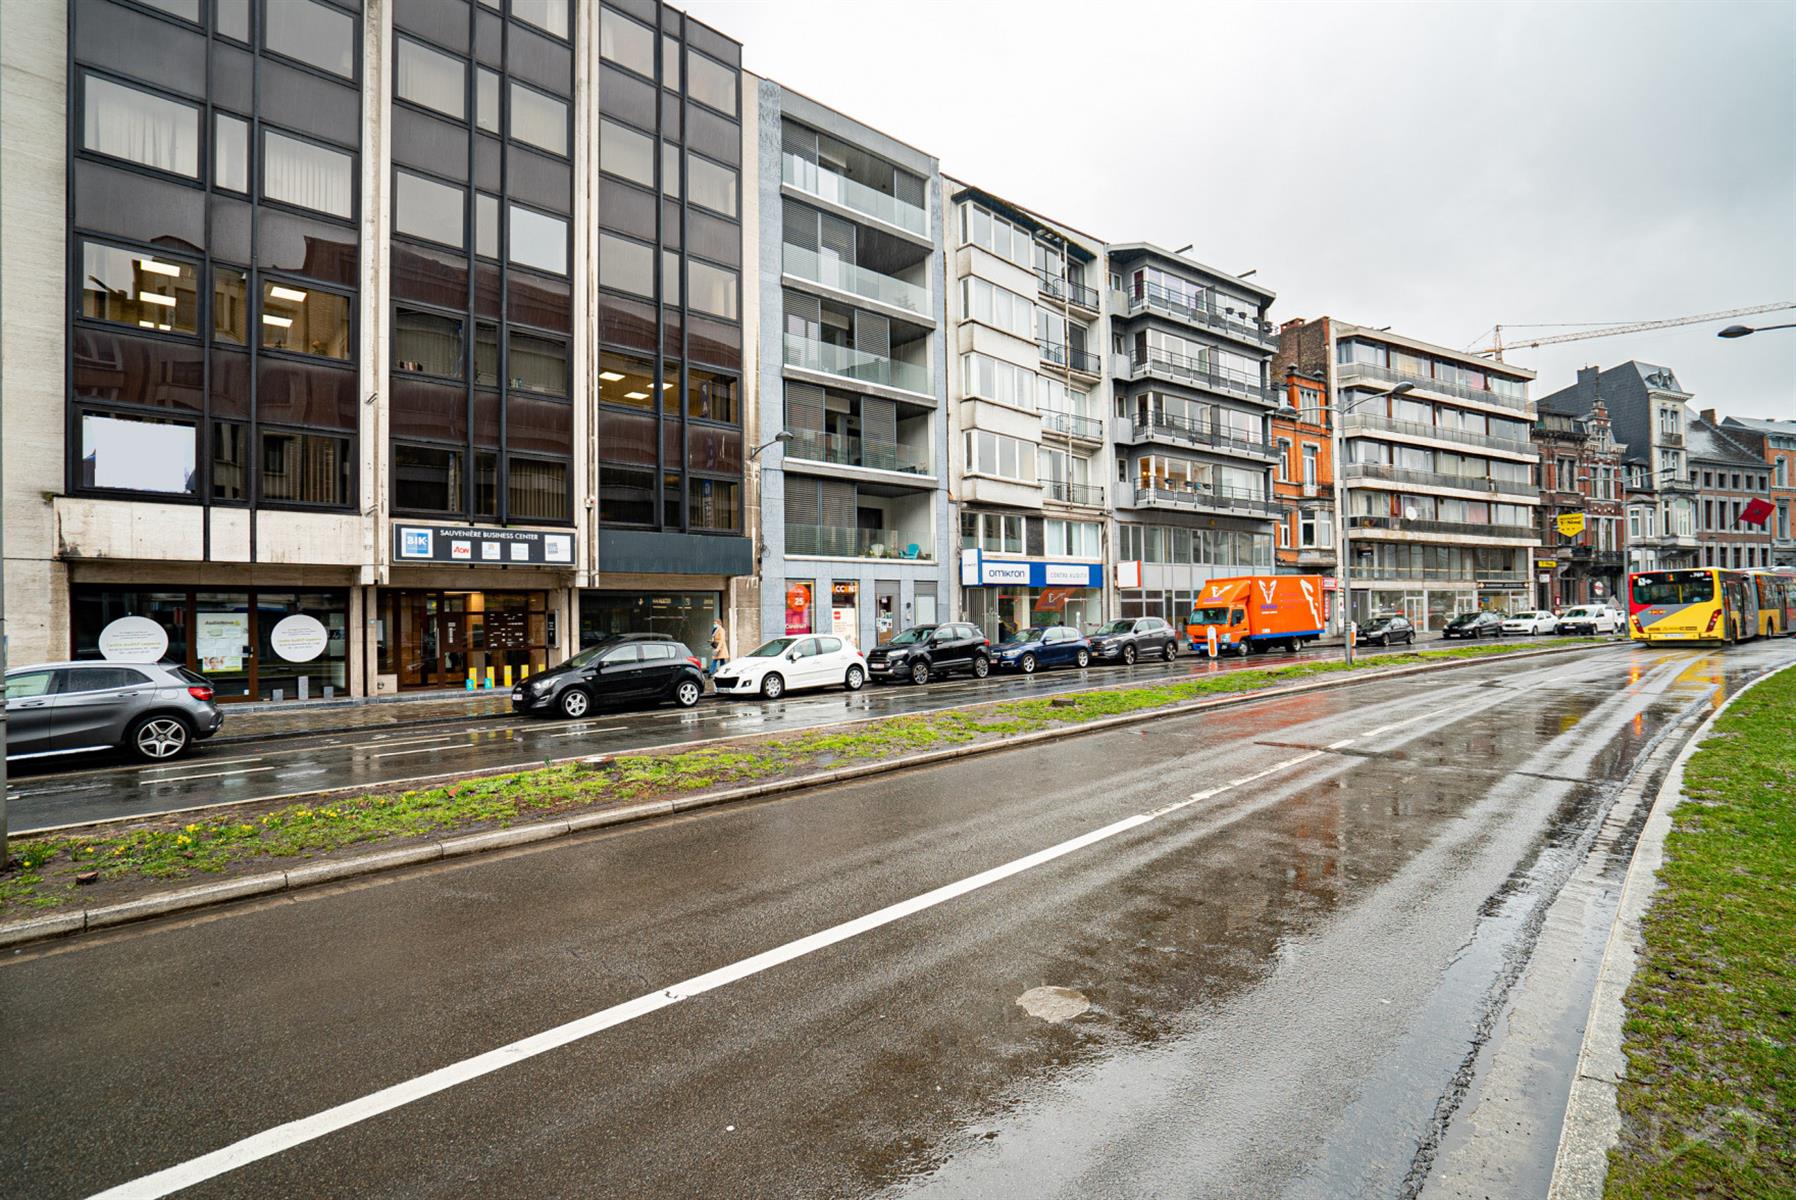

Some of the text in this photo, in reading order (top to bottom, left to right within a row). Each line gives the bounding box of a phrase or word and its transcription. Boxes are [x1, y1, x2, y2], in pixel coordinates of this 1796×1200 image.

[440, 529, 539, 541] SAUVENIÈRE BUSINESS CENTER
[988, 569, 1025, 578] omikron
